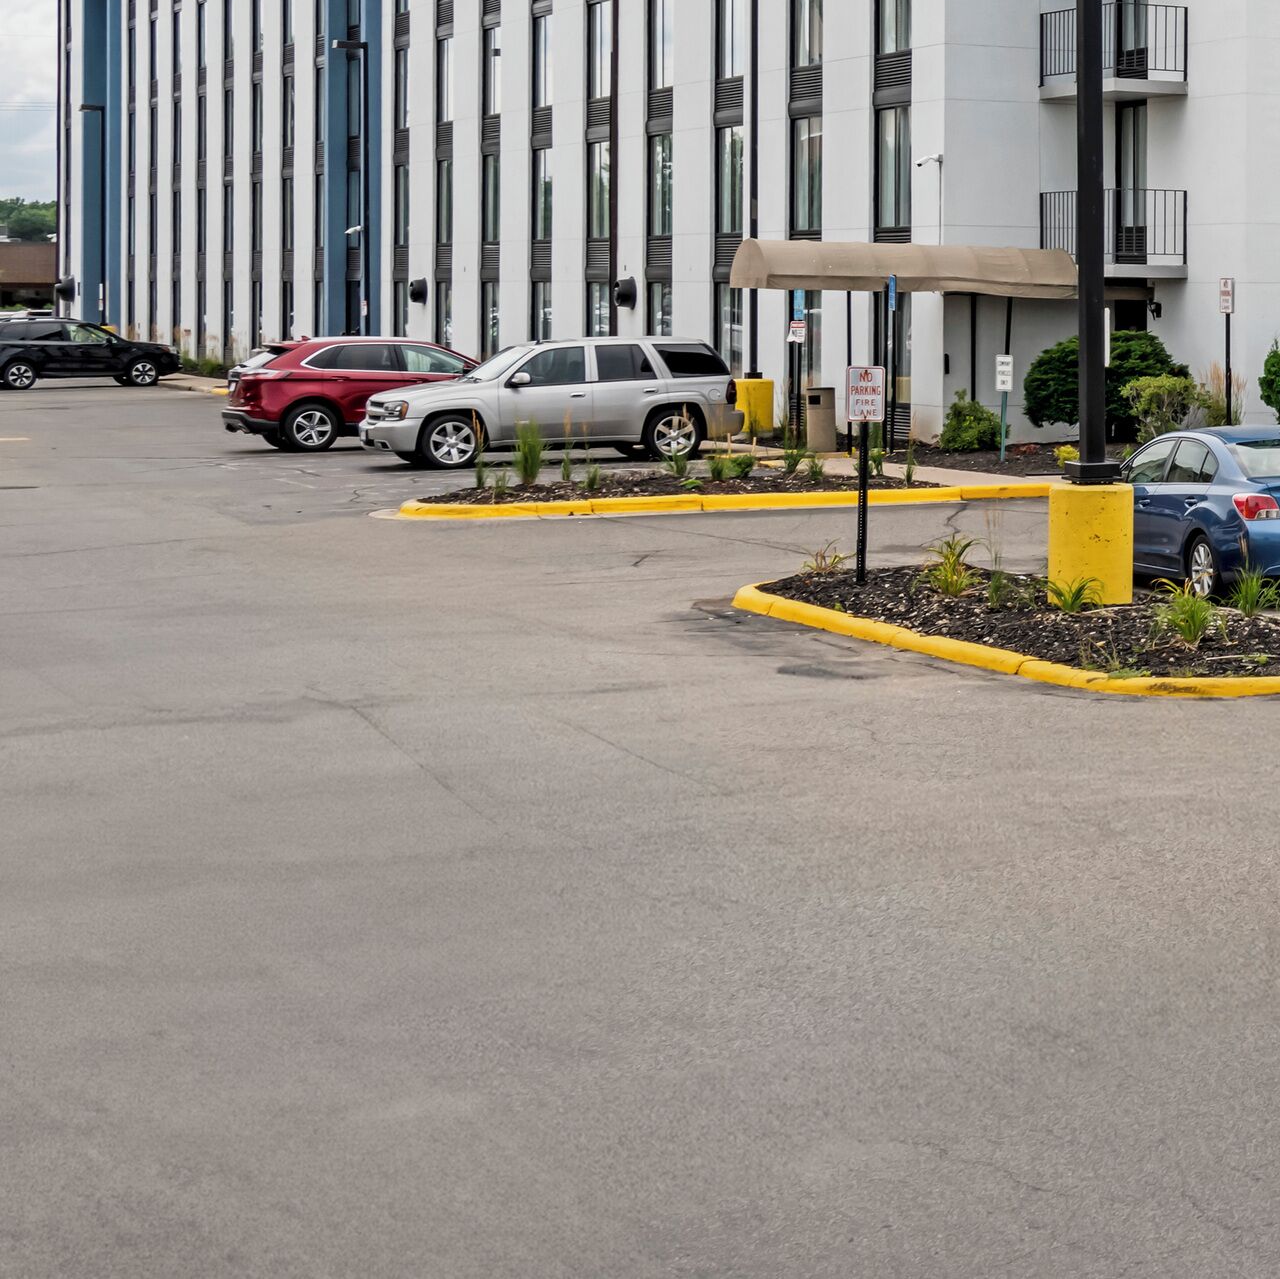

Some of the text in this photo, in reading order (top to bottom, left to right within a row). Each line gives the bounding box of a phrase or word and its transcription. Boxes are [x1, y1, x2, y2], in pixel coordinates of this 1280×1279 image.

[859, 372, 873, 382] NO
[850, 385, 881, 396] PARKING
[853, 409, 878, 417] LANE
